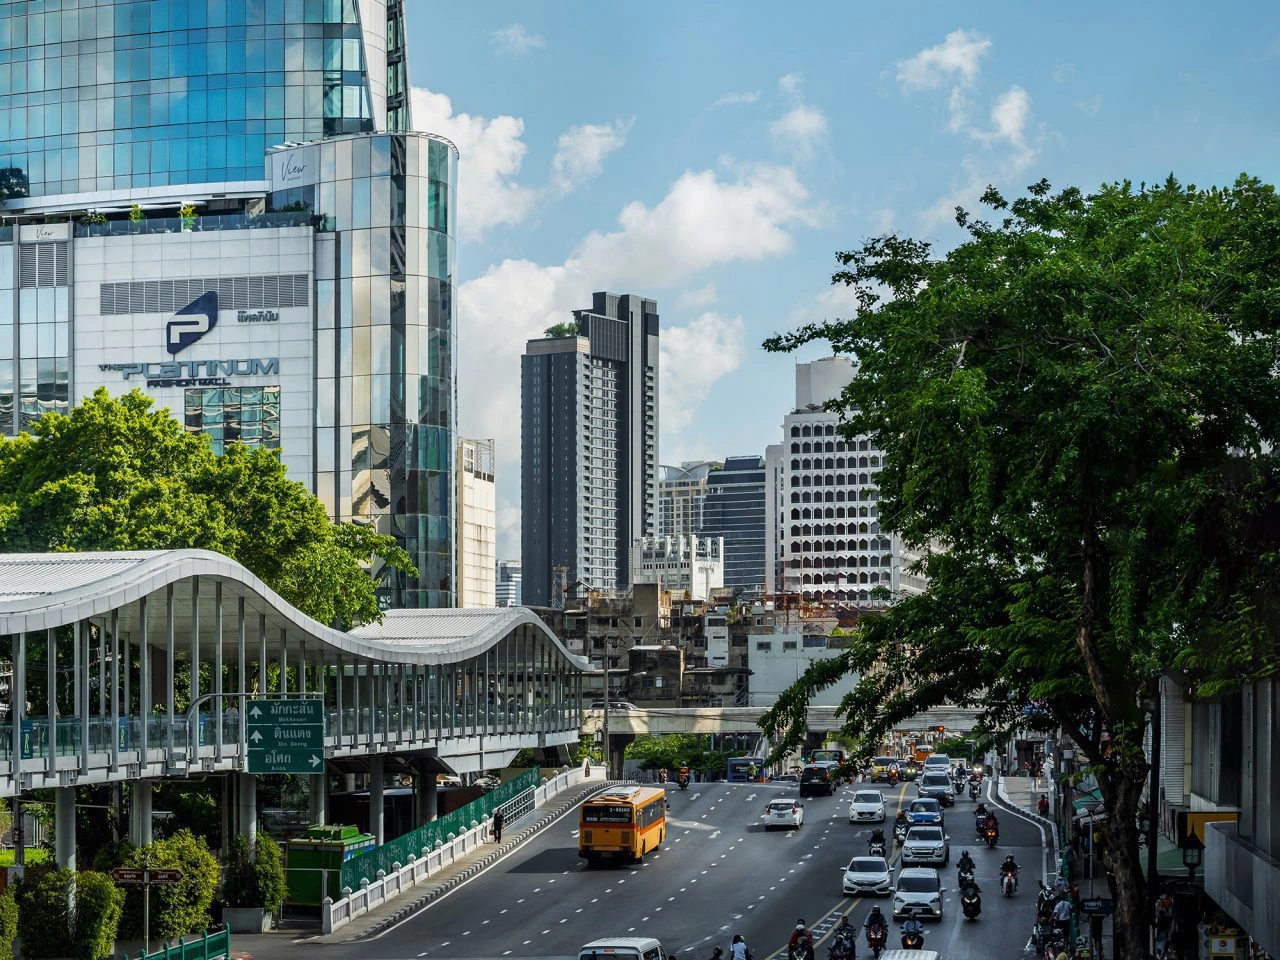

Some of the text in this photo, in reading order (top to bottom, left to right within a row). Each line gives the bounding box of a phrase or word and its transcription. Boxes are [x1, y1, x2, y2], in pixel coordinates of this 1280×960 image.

[281, 153, 307, 182] View
[98, 363, 123, 372] THE
[147, 377, 231, 388] FASHION MALL
[270, 701, 314, 715] มักกะสัน
[274, 727, 311, 739] ดินแดง
[265, 750, 291, 764] อโศก
